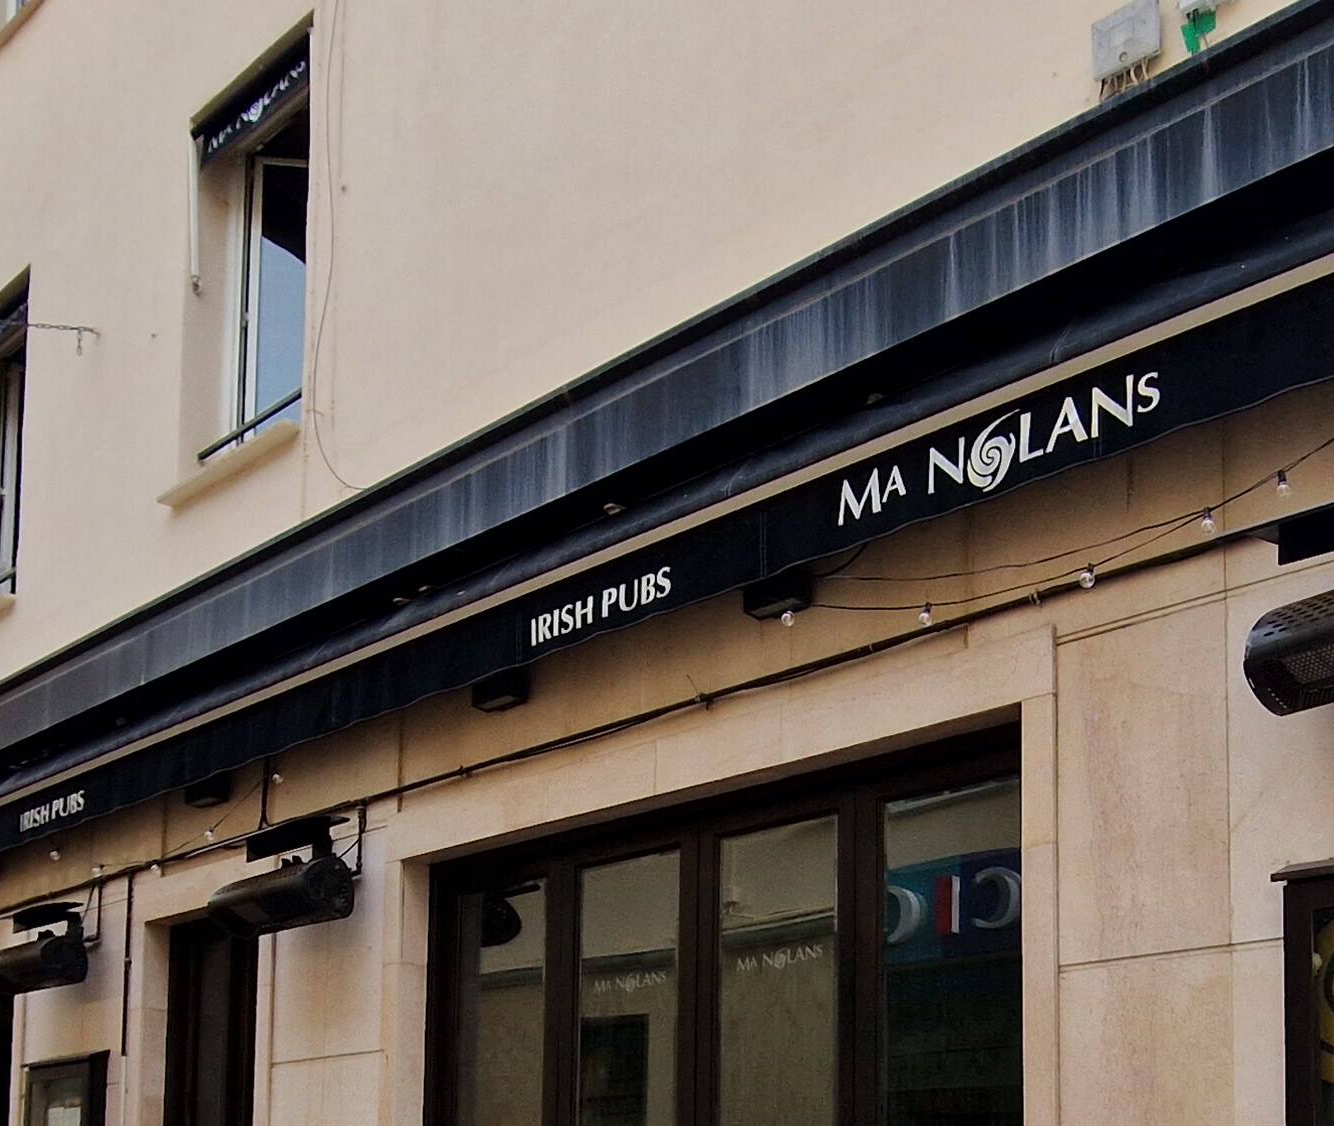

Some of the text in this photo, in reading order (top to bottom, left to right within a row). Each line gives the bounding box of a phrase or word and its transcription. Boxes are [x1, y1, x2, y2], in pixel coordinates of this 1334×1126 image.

[838, 466, 906, 526] MA
[531, 567, 672, 647] IRISH PUBS
[20, 790, 85, 832] IRISH PUBS
